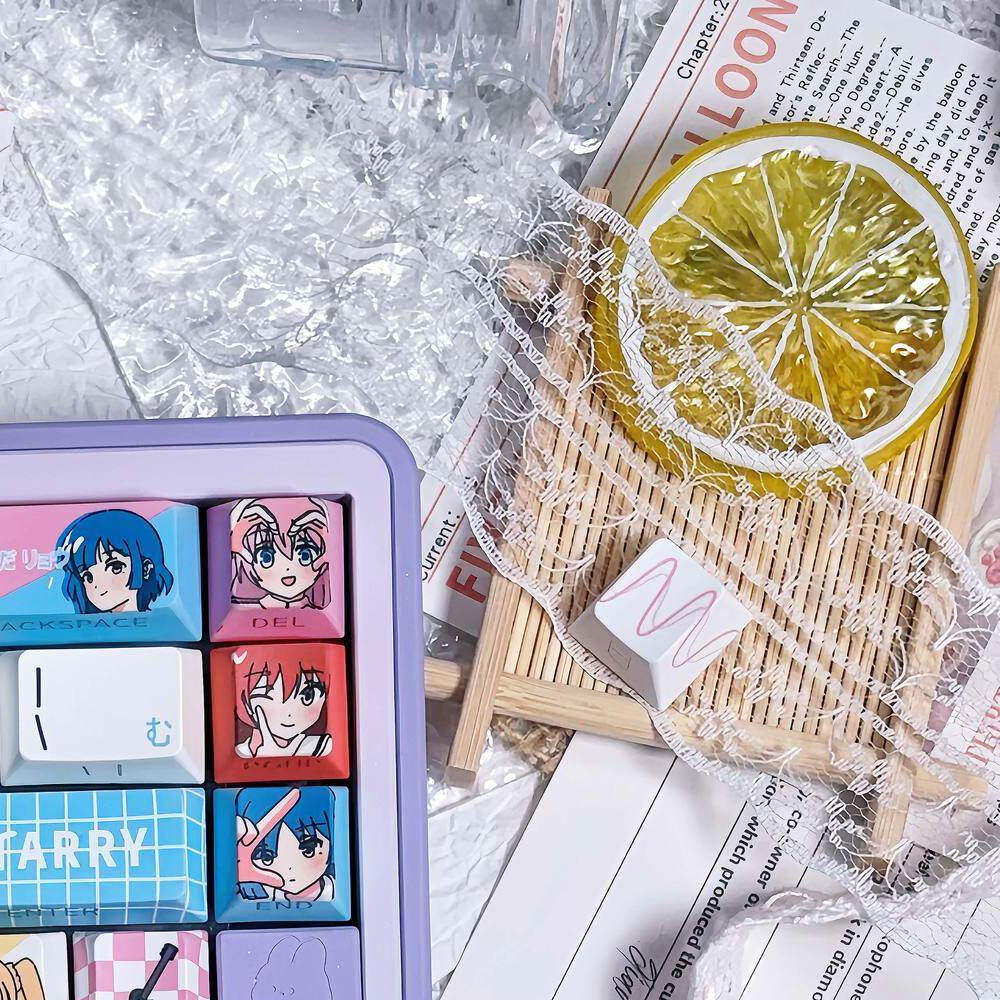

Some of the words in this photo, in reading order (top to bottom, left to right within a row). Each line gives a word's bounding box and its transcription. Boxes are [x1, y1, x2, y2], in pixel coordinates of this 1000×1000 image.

[911, 57, 933, 91] gives
[769, 93, 785, 116] and
[913, 136, 930, 152] by
[925, 112, 941, 131] the
[936, 63, 967, 107] balloon
[937, 125, 954, 147] day
[951, 99, 967, 120] did
[965, 74, 980, 95] not
[958, 128, 970, 141] to
[983, 77, 997, 89] it
[964, 145, 980, 169] and
[975, 168, 985, 184] of
[252, 616, 305, 629] DEL
[146, 717, 171, 747] む
[729, 816, 759, 865] which
[8, 904, 99, 917] ENTER
[687, 866, 734, 950] produced
[840, 928, 861, 946] in
[671, 951, 696, 979] the
